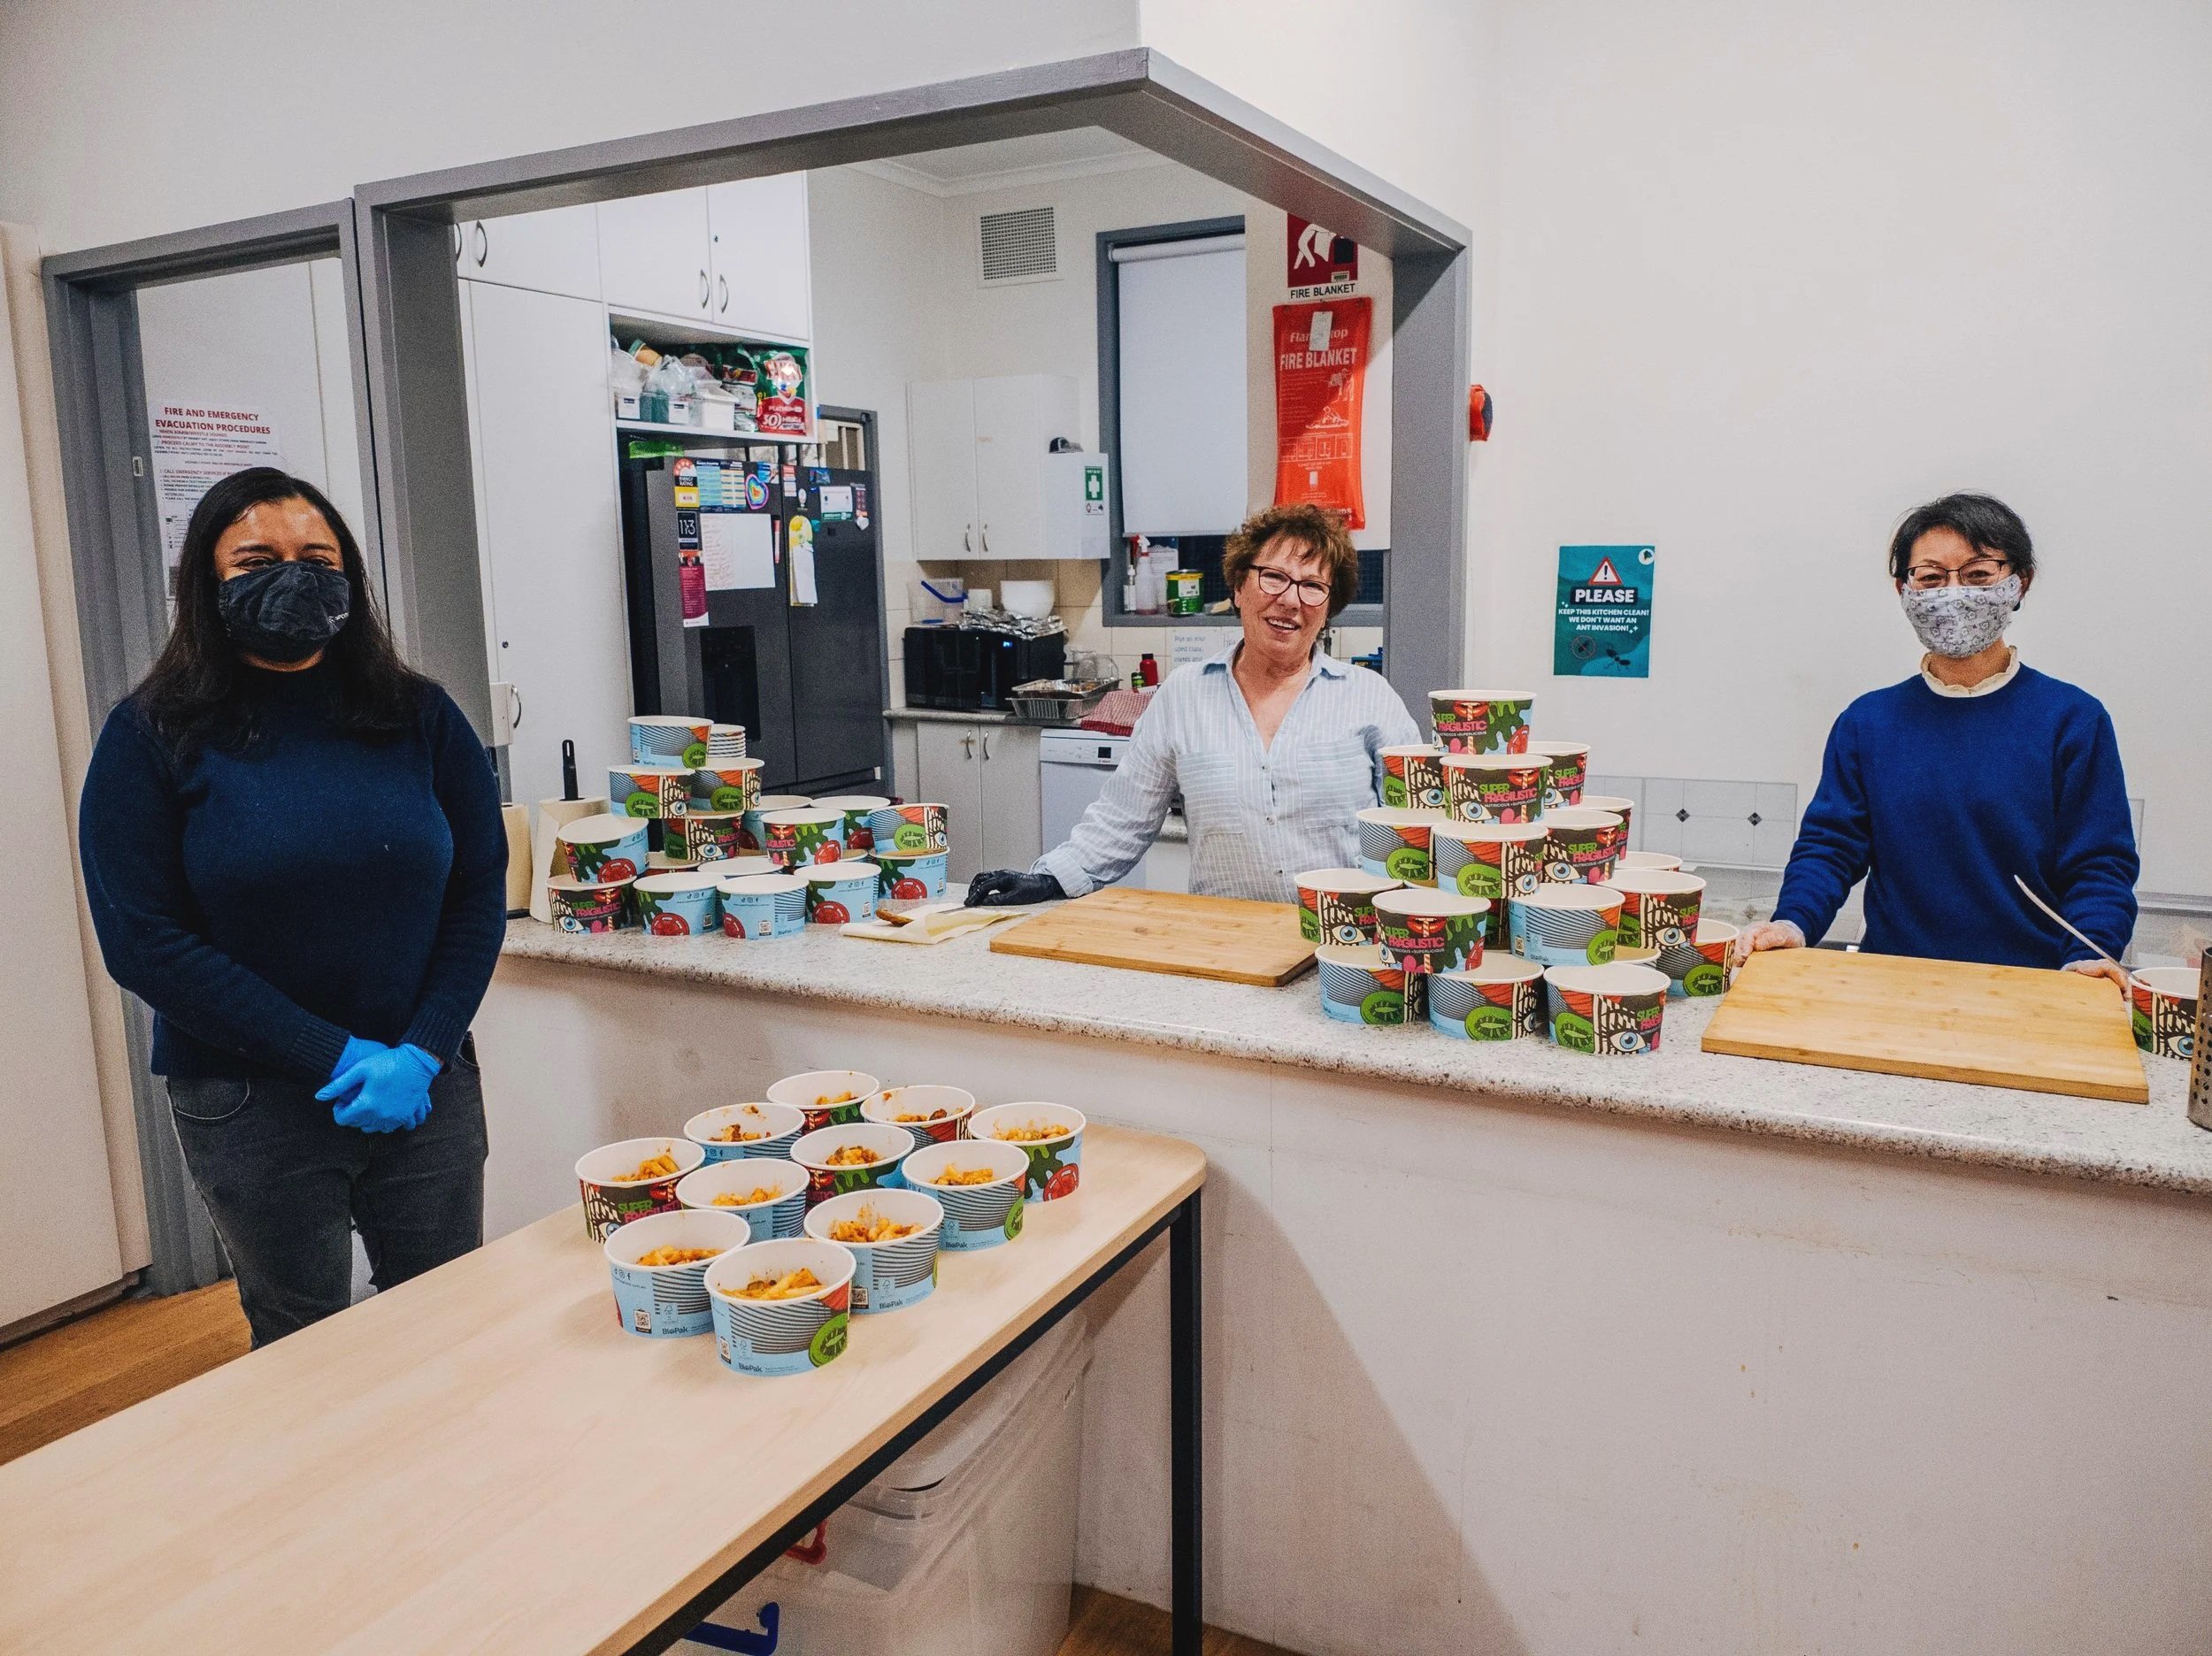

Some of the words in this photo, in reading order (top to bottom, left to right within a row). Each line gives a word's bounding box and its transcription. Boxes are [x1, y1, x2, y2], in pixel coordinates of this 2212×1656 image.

[1290, 288, 1310, 299] FIRE
[1313, 283, 1356, 296] BLANKET
[1279, 352, 1303, 371] FIRE
[1306, 348, 1357, 369] BLANKET
[165, 407, 183, 416] FIRE
[208, 410, 259, 421] EMERGENCY
[155, 419, 214, 431] EVACUATION
[216, 424, 271, 434] PROCEDURES
[1575, 589, 1635, 603] PLEASE
[1435, 713, 1456, 723] SUPER
[1439, 720, 1487, 732] FRAGILISTIC
[1555, 767, 1578, 778] SUPER
[1479, 783, 1509, 794] SUPER
[1484, 787, 1538, 803] FRAGILISTIC
[1568, 842, 1597, 854] SUPER
[572, 901, 595, 910] SUPER
[1385, 926, 1409, 938] SUPER
[1388, 936, 1445, 948] FRAGILISTIC
[618, 1200, 653, 1214] SUPER
[879, 1299, 902, 1309] BioPak
[662, 1326, 688, 1335] BioPak
[738, 1362, 763, 1373] BioPak
